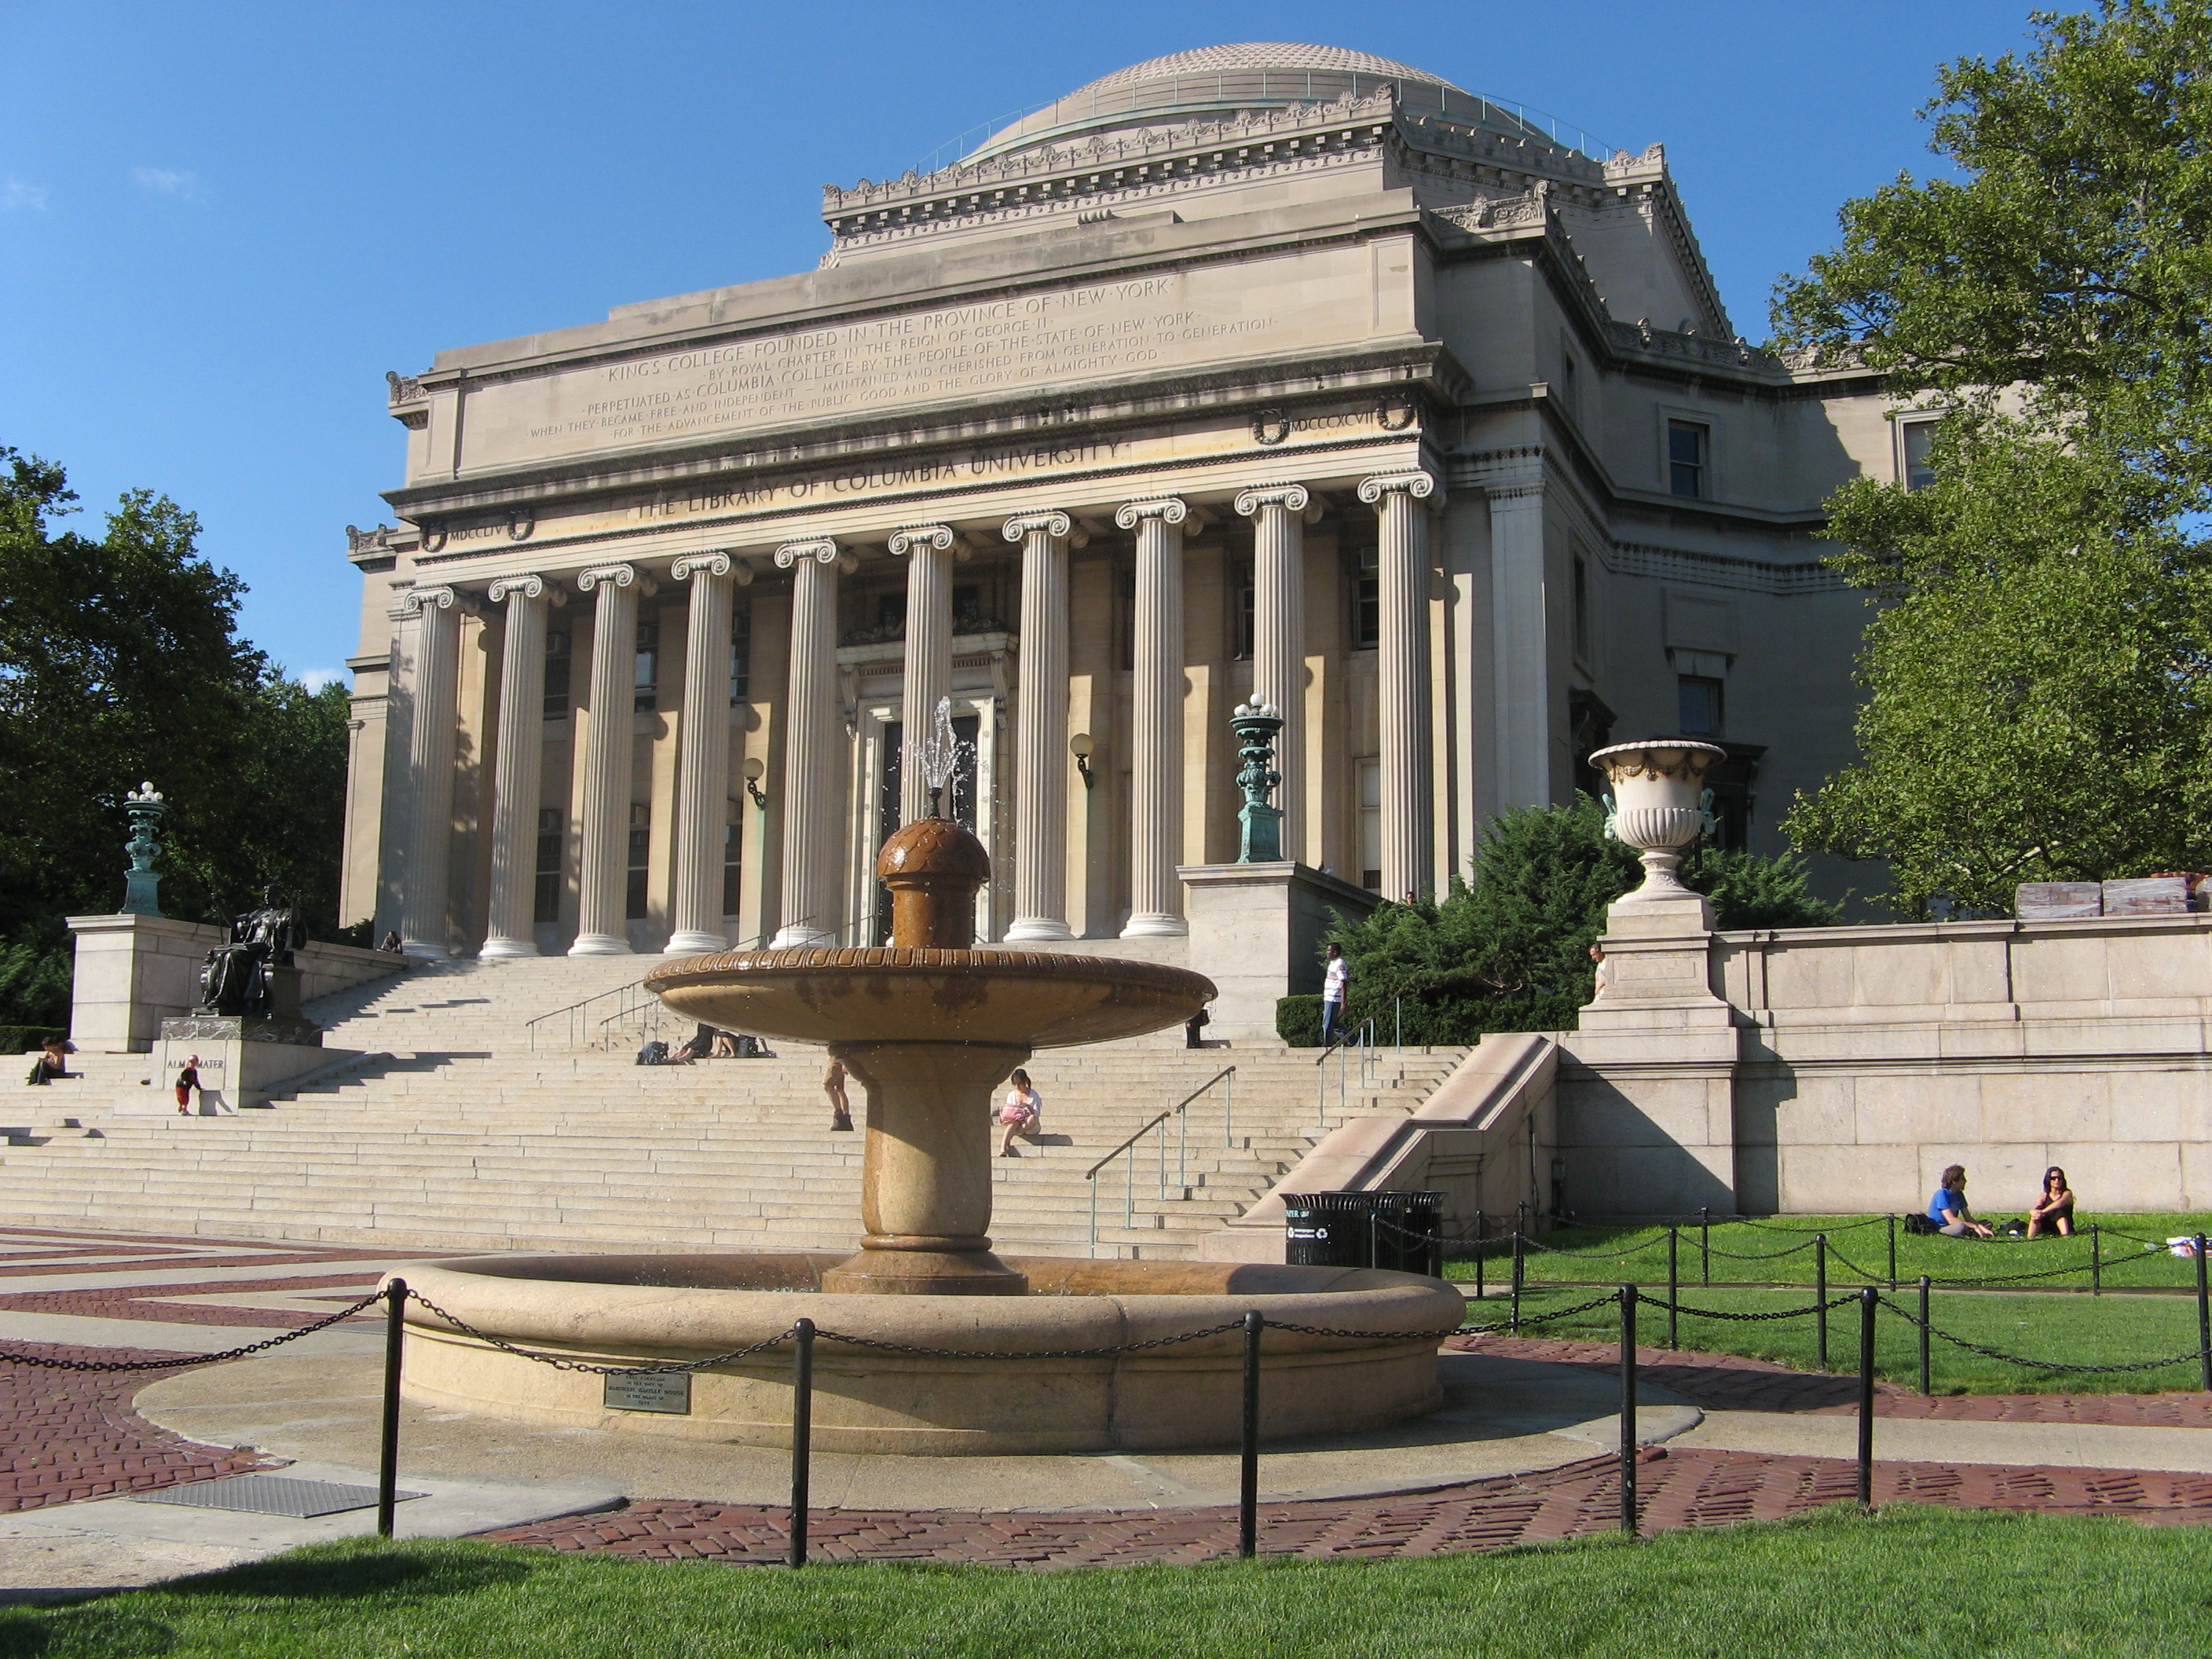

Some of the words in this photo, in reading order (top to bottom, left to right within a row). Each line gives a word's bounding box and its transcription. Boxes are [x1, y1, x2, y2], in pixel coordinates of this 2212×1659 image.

[588, 393, 670, 416] PERPETUATED
[676, 388, 690, 401] AS
[697, 375, 775, 397] COLUMBIA
[782, 361, 857, 383] COLLEGE
[861, 359, 877, 372] BY
[884, 353, 912, 367] THE
[918, 345, 968, 364] PEOPLE
[974, 340, 994, 354] OF
[1001, 336, 1029, 351] THE
[1036, 328, 1077, 346] STATE
[1084, 324, 1104, 338] OF
[1111, 318, 1145, 332] NEW
[1154, 310, 1195, 328] YORK
[609, 361, 660, 382] KING'S
[668, 346, 745, 371] COLLEGE
[754, 331, 837, 358] FOUNDED
[848, 328, 866, 342] IN
[877, 318, 913, 336] THE
[924, 302, 1016, 331] PROVINCE
[1025, 296, 1051, 313] OF
[1062, 288, 1106, 309] NEW
[1116, 278, 1170, 300] YORK
[709, 368, 723, 380] BY
[731, 363, 771, 377] ROYAL
[778, 351, 836, 369] CHARTER
[844, 346, 859, 359] IN
[866, 341, 892, 354] THE
[900, 334, 940, 350] REIGN
[948, 329, 967, 342] OF
[974, 320, 1030, 338] GEORGE
[1037, 317, 1047, 329] II
[530, 424, 562, 438] WHEN
[568, 419, 595, 432] THEY
[601, 412, 643, 427] BECAME
[650, 406, 677, 419] FREE
[683, 401, 708, 414] AND
[714, 387, 796, 409] INDEPENDENT
[822, 374, 899, 393] MAINTAINED
[906, 367, 932, 380] AND
[939, 355, 1012, 375] CHERISHED
[1020, 349, 1056, 363] FROM
[1063, 335, 1149, 356] GENERATION
[1157, 331, 1175, 342] TO
[1182, 317, 1273, 339] GENERATION
[613, 428, 633, 438] FOR
[641, 423, 661, 434] THE
[668, 408, 753, 431] ADVANCEMENT
[760, 405, 775, 416] OF
[782, 401, 804, 413] THE
[811, 394, 852, 408] PUBLIC
[860, 387, 897, 401] GOOD
[903, 382, 930, 395] AND
[937, 376, 962, 390] THE
[969, 369, 1013, 385] GLORY
[1020, 366, 1038, 378] OF
[1045, 354, 1118, 375] ALMIGHTY
[1126, 348, 1158, 363] GOD
[1291, 412, 1373, 432] MDCCCXCVII
[636, 496, 676, 518] THE
[688, 482, 781, 512] LIBRARY
[789, 476, 820, 498] OF
[833, 460, 956, 492] COLUMBIA
[971, 436, 1122, 474] UNIVERSITY
[450, 525, 502, 542] MDCCLIV
[167, 1060, 189, 1068] ALM
[196, 1060, 223, 1068] MATER
